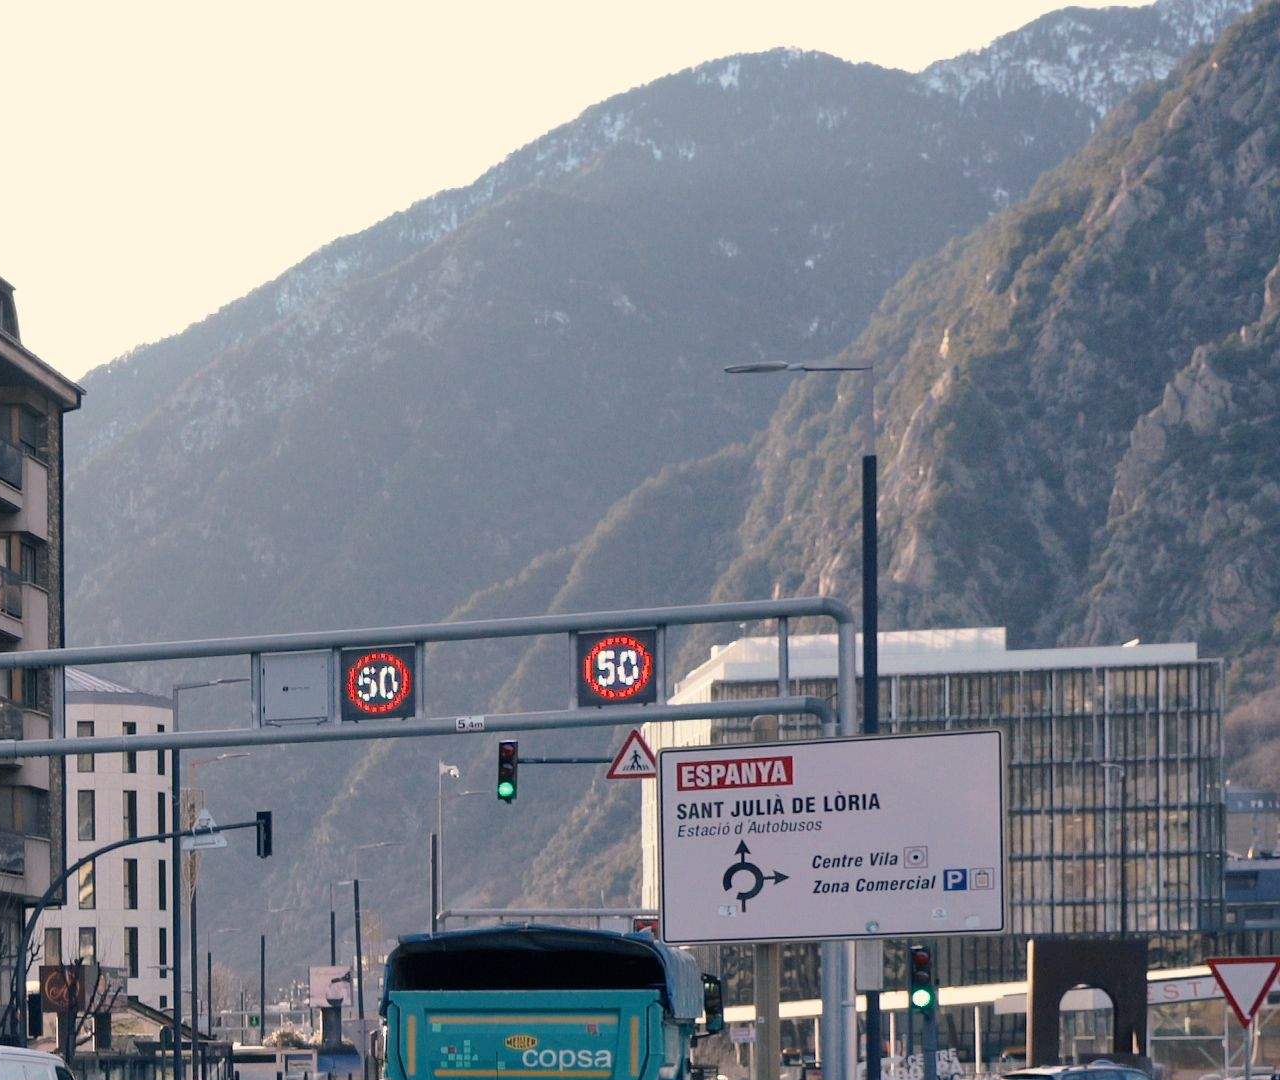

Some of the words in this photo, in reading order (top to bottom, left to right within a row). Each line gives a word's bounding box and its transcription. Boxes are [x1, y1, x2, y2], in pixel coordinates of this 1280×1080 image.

[597, 649, 640, 688] 50
[357, 665, 398, 701] 50
[680, 760, 788, 789] ESPANYA
[676, 802, 725, 820] SANT
[730, 794, 785, 818] JULIÀ
[792, 797, 816, 814] DE
[824, 791, 881, 812] LÒRIA
[677, 822, 730, 838] Estació
[812, 854, 863, 869] Centre
[870, 852, 899, 866] Vila
[813, 880, 850, 894] Zona
[856, 875, 937, 892] Comercial
[522, 1048, 612, 1072] copsa
